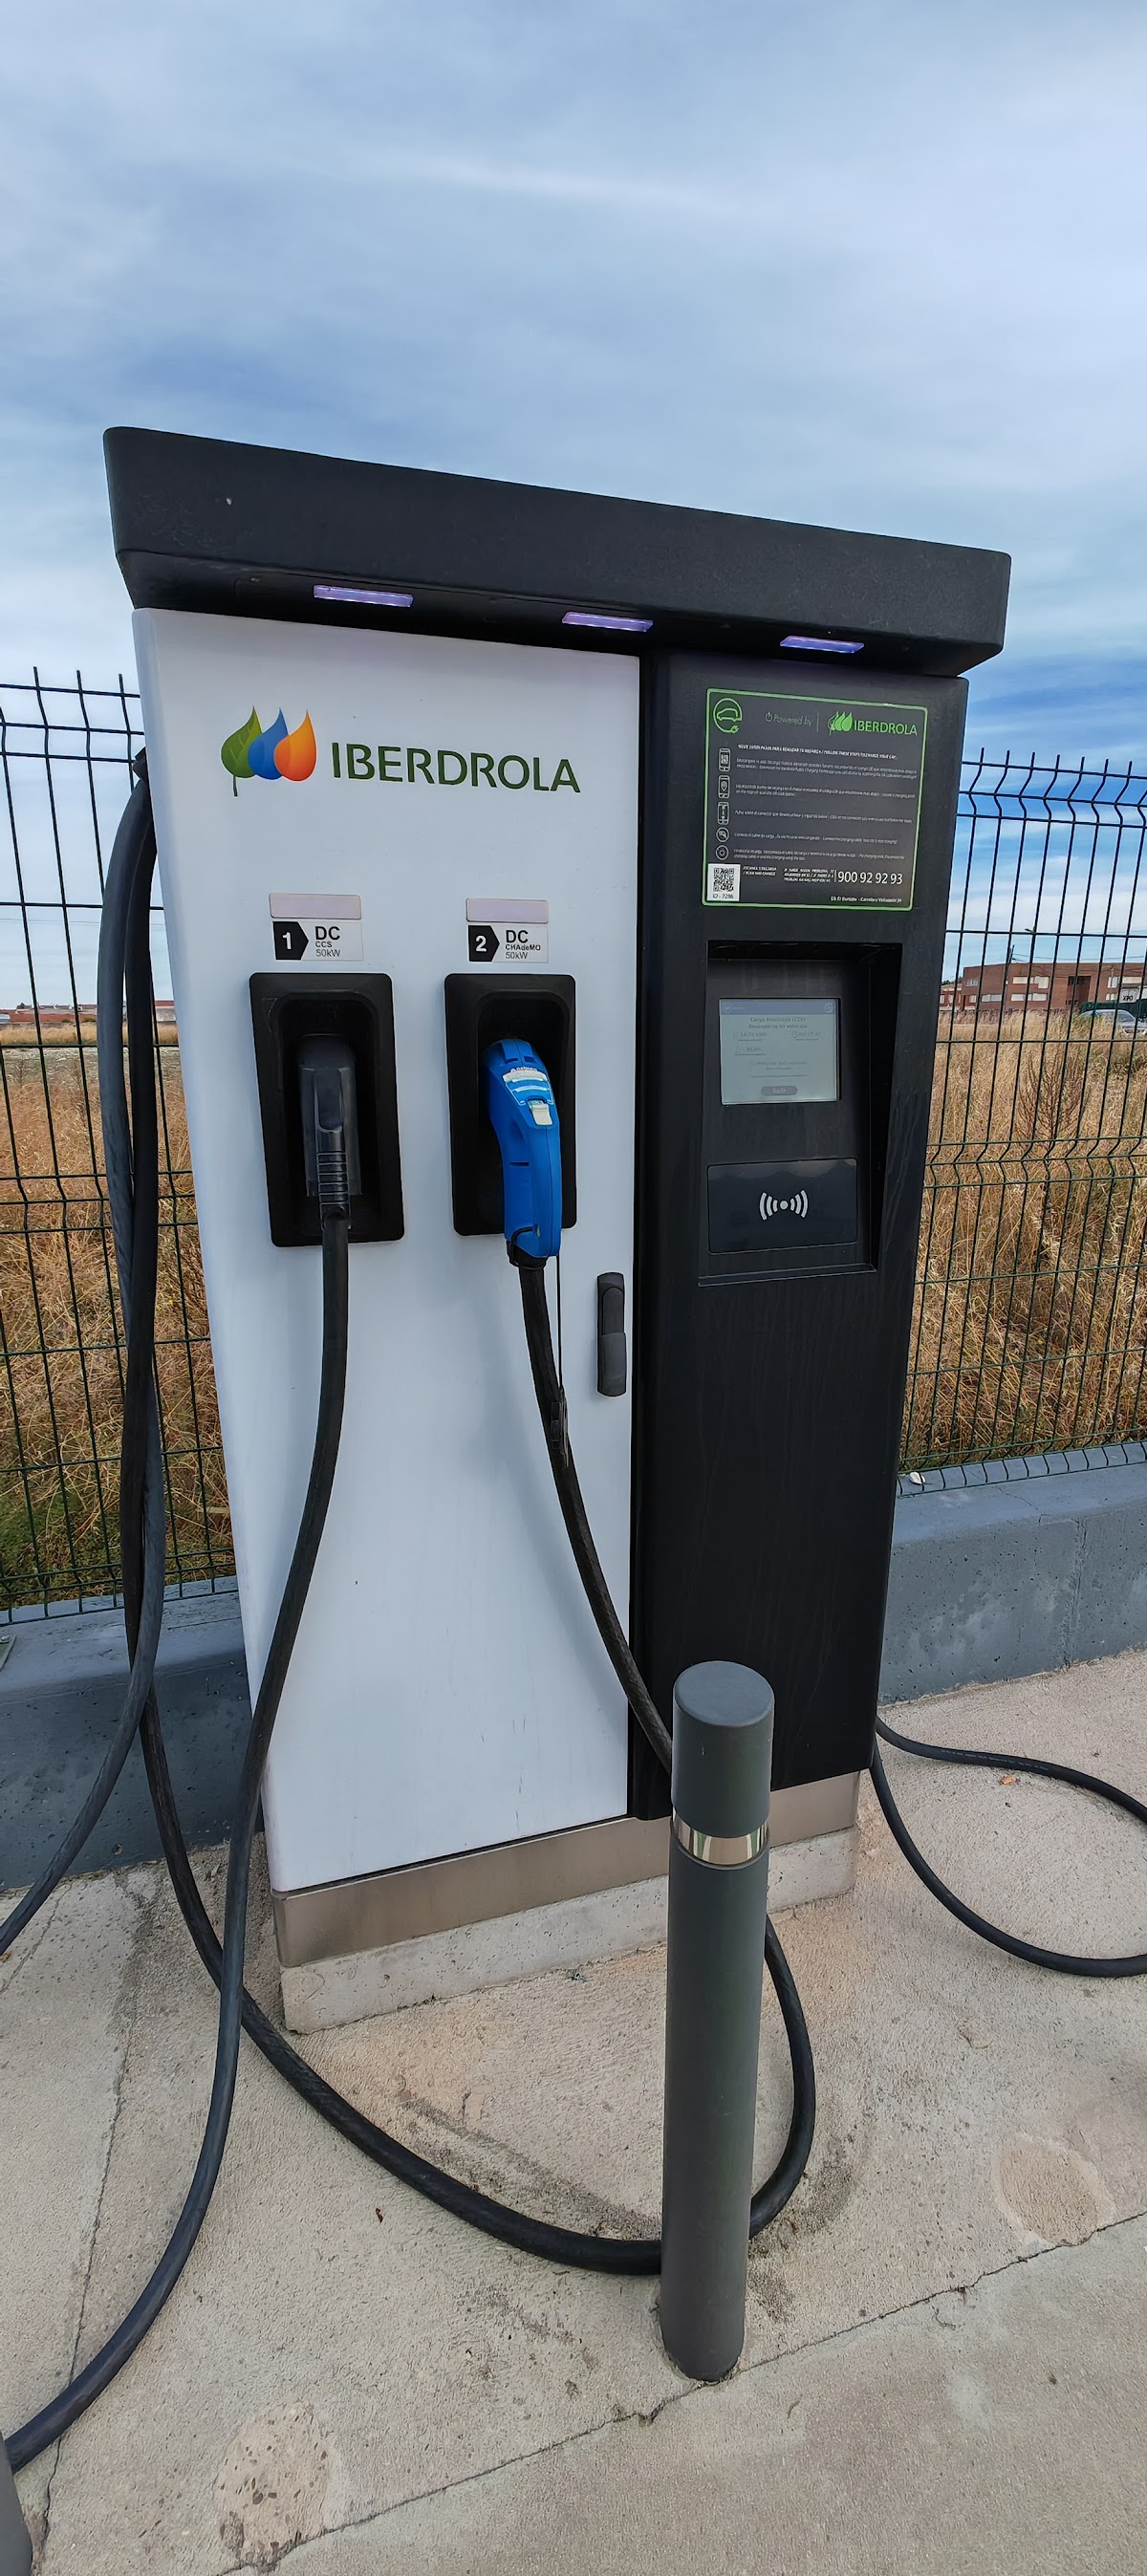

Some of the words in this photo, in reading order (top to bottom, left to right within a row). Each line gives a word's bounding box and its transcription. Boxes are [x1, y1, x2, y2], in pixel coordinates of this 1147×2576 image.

[854, 719, 918, 736] IBERDROLA
[331, 742, 582, 794] IBERDROLA
[837, 871, 858, 883] 900
[859, 872, 873, 884] 92
[875, 872, 888, 884] 92
[890, 873, 903, 885] 93
[282, 932, 292, 950] 1
[314, 925, 341, 942] DC
[505, 929, 530, 943] DC
[475, 935, 487, 953] 2
[505, 943, 542, 952] CHAdeMO
[315, 948, 341, 958] 50kW
[505, 951, 529, 960] 50kW
